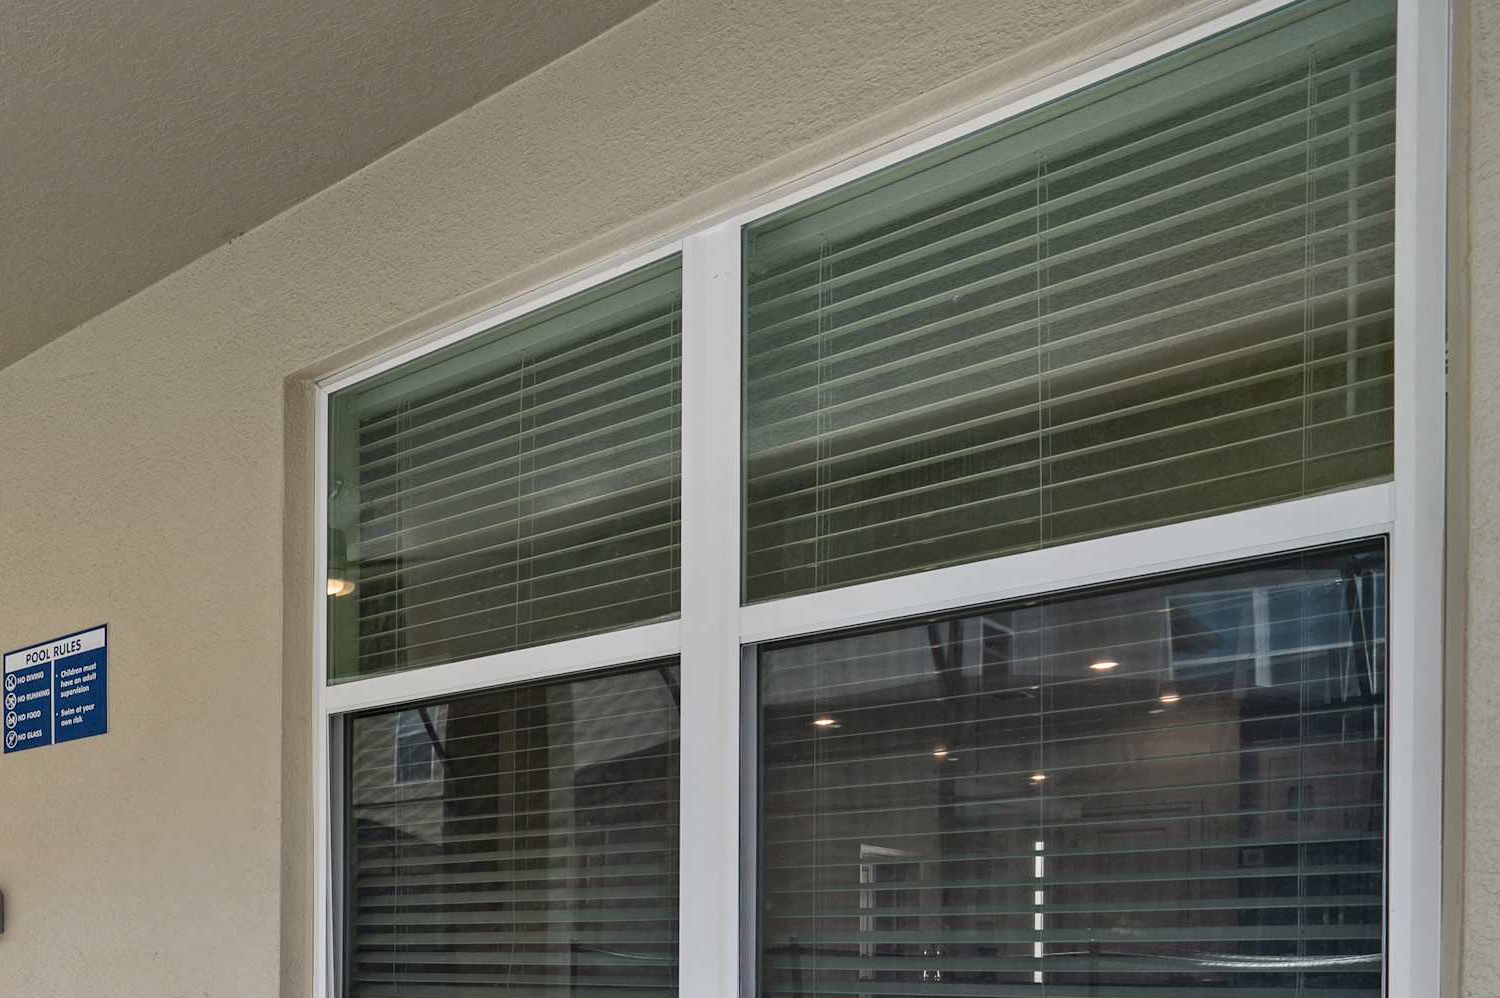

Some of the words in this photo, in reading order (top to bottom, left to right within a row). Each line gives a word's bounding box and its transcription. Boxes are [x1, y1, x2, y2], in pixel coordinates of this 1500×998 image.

[26, 649, 50, 665] POOL
[53, 639, 81, 657] RULES
[60, 668, 82, 678] Children
[83, 662, 96, 671] must
[16, 676, 26, 684] NO
[27, 671, 44, 681] DIVING
[60, 680, 73, 688] have
[73, 677, 82, 685] an
[82, 672, 97, 682] adult
[17, 694, 26, 703] NO
[26, 689, 50, 699] RUNNING
[60, 686, 89, 698] supervision
[17, 713, 26, 722] NO
[26, 710, 41, 720] FOOD
[60, 707, 75, 717] Swim
[75, 704, 82, 714] at
[82, 703, 95, 714] your
[60, 718, 73, 727] own
[73, 715, 83, 724] risk
[17, 732, 26, 741] NO
[27, 729, 42, 739] GLASS
